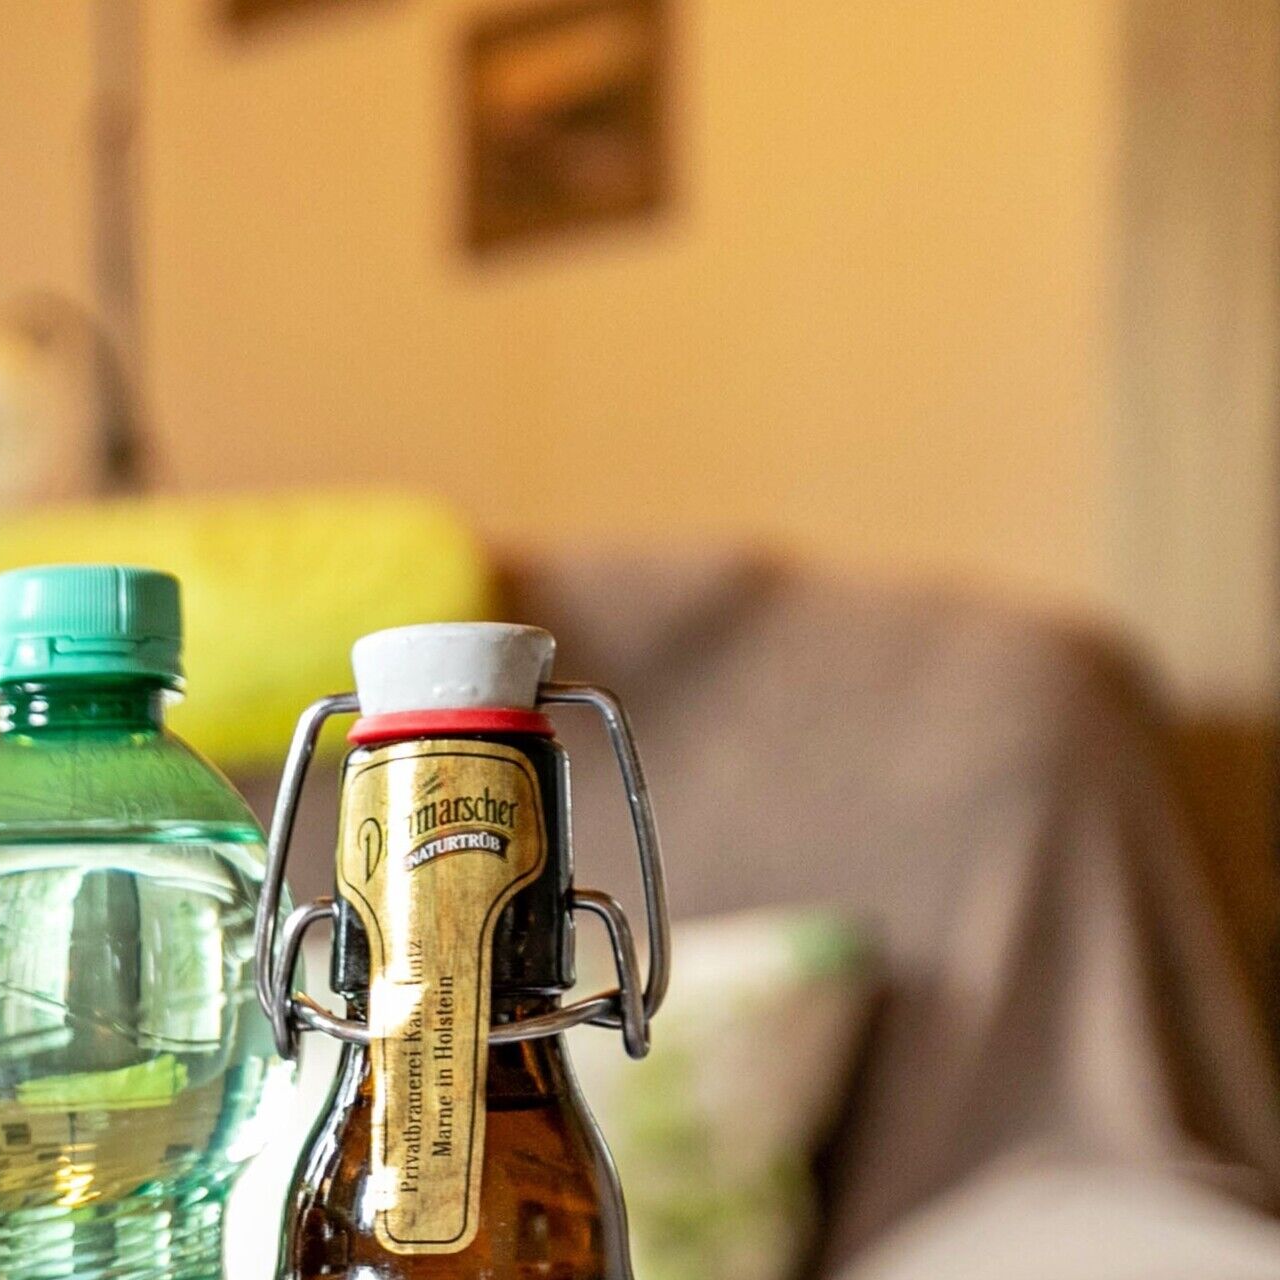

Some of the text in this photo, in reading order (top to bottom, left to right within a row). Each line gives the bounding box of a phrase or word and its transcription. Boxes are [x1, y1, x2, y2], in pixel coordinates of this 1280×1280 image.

[401, 1052, 424, 1193] Privatbrauerei
[432, 974, 454, 1157] Marne in Holstein
